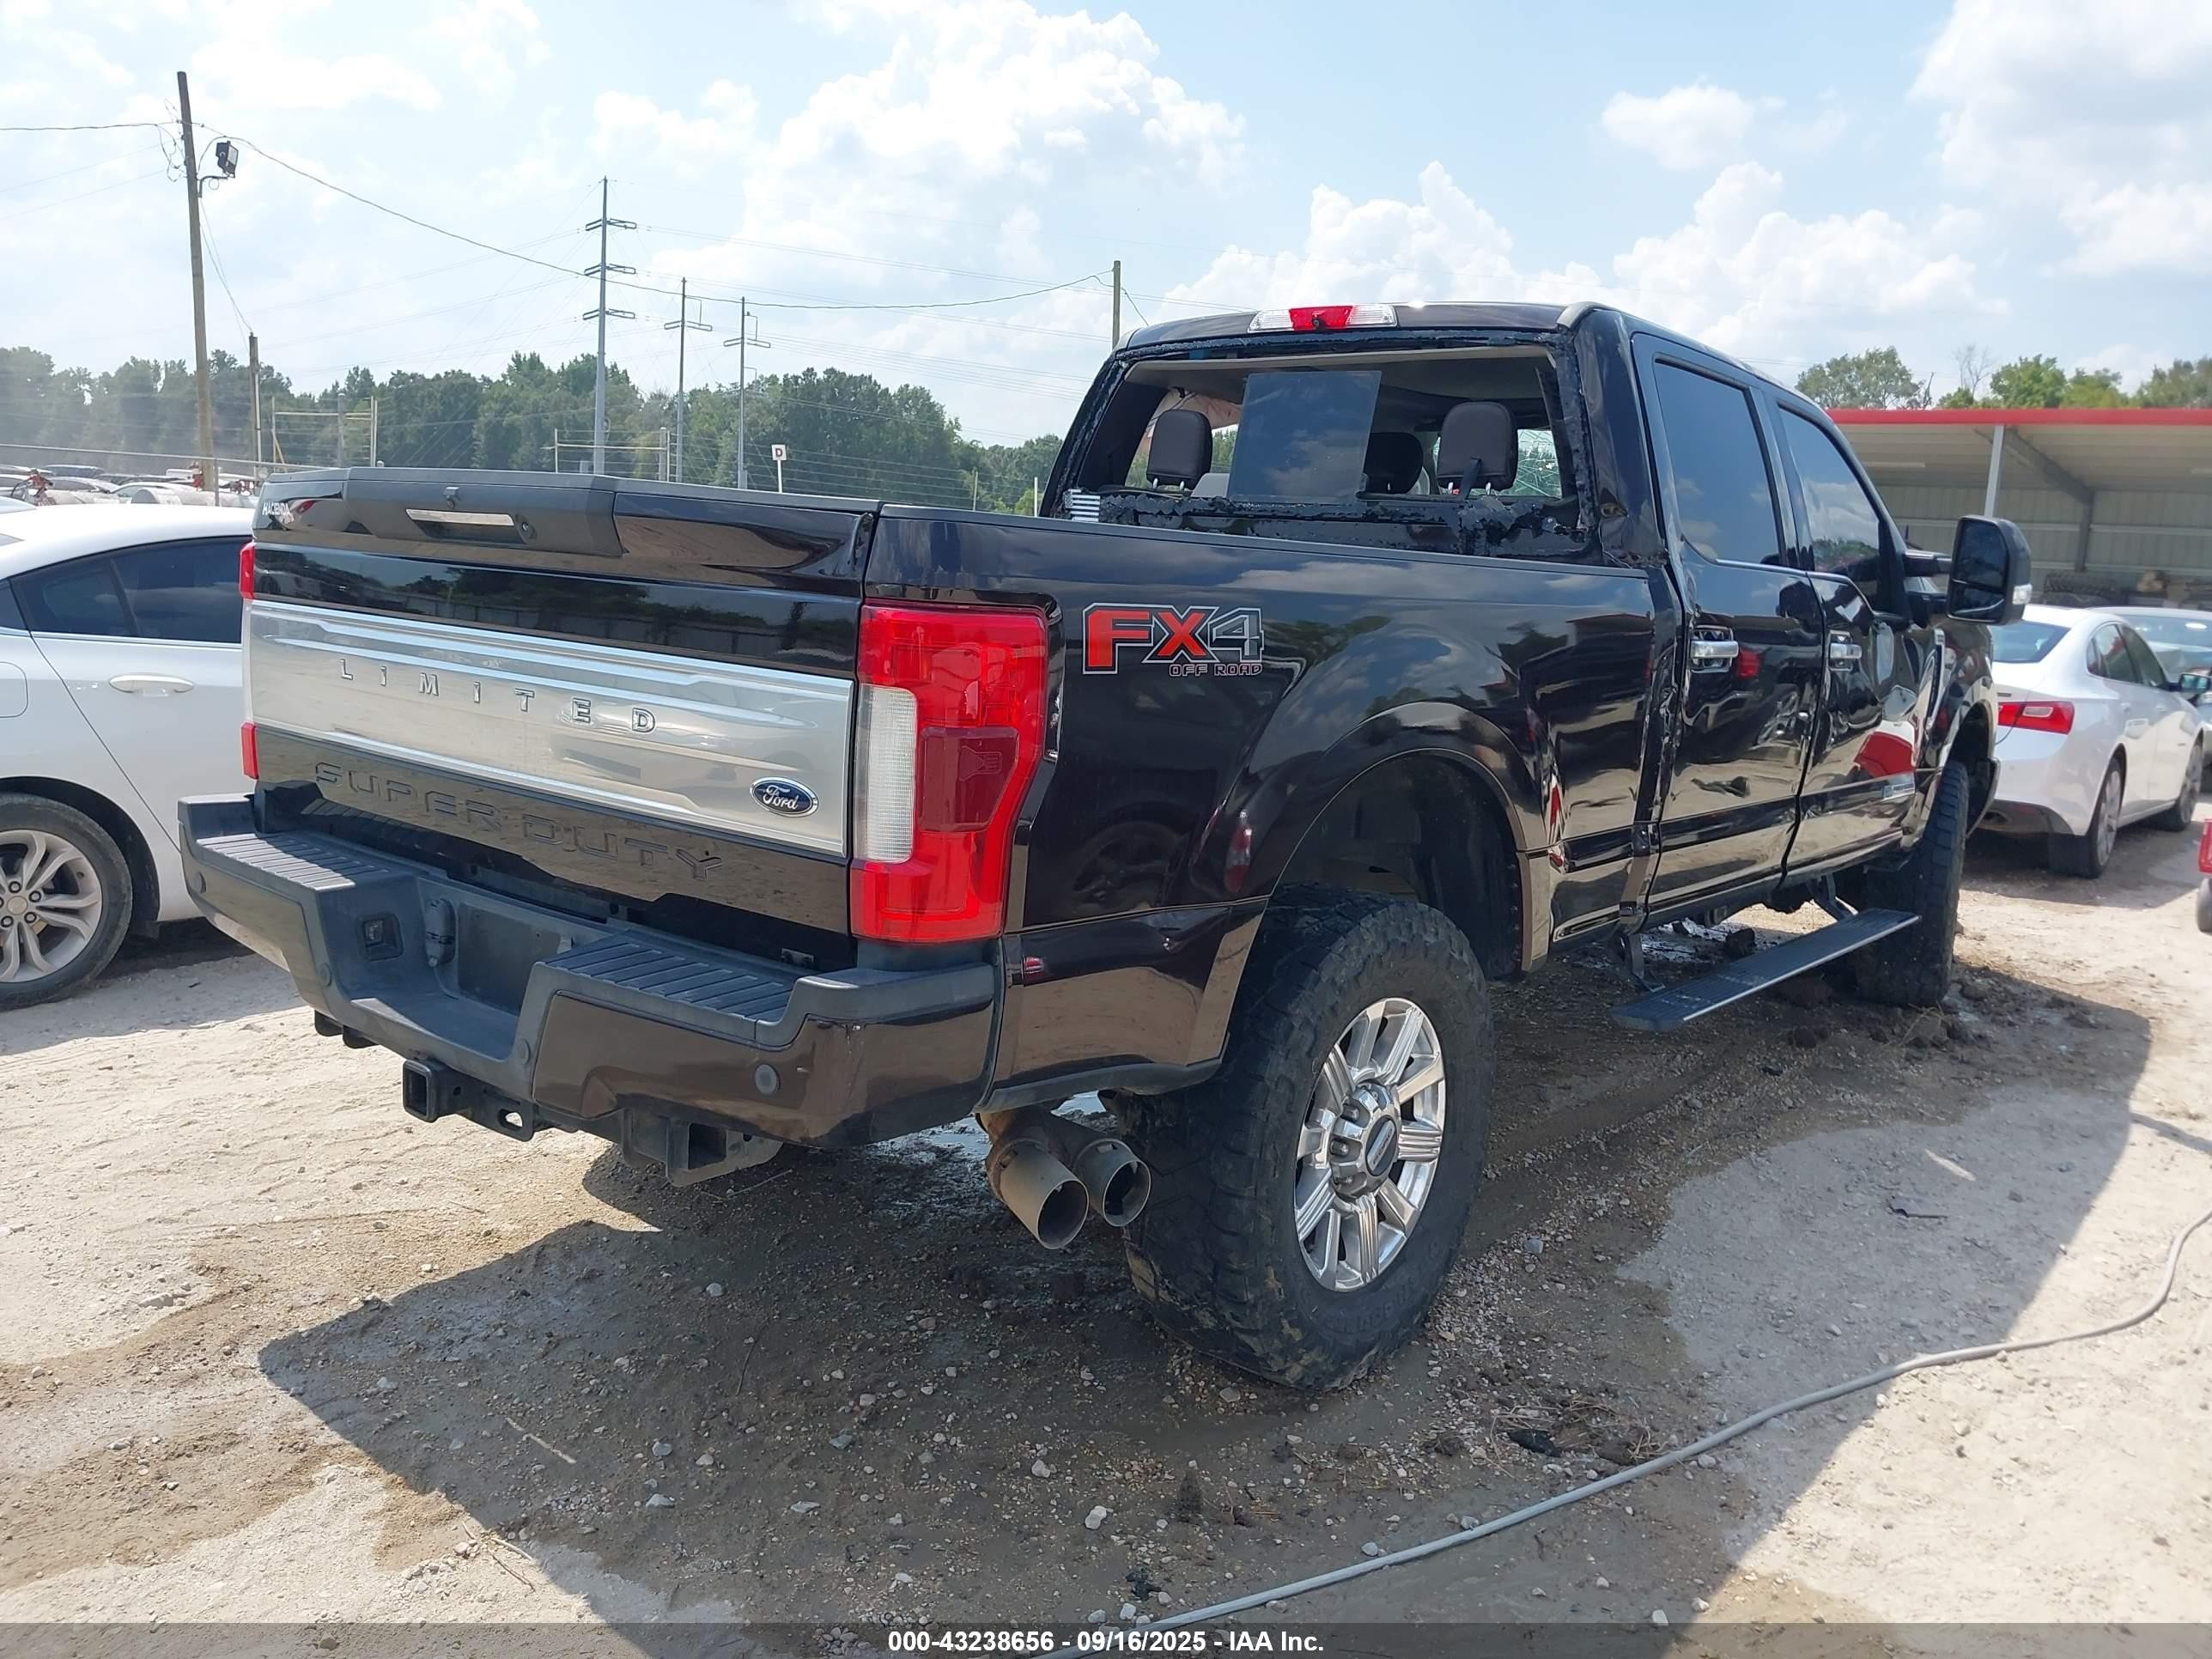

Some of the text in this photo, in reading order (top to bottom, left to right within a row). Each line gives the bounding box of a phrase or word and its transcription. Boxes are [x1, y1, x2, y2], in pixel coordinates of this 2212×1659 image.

[775, 448, 783, 458] D
[1083, 602, 1264, 674] FX4
[1169, 663, 1263, 677] OFF ROAD
[340, 658, 657, 734] LIMITED
[315, 761, 722, 881] SUPER DUTY
[763, 784, 799, 810] Ford
